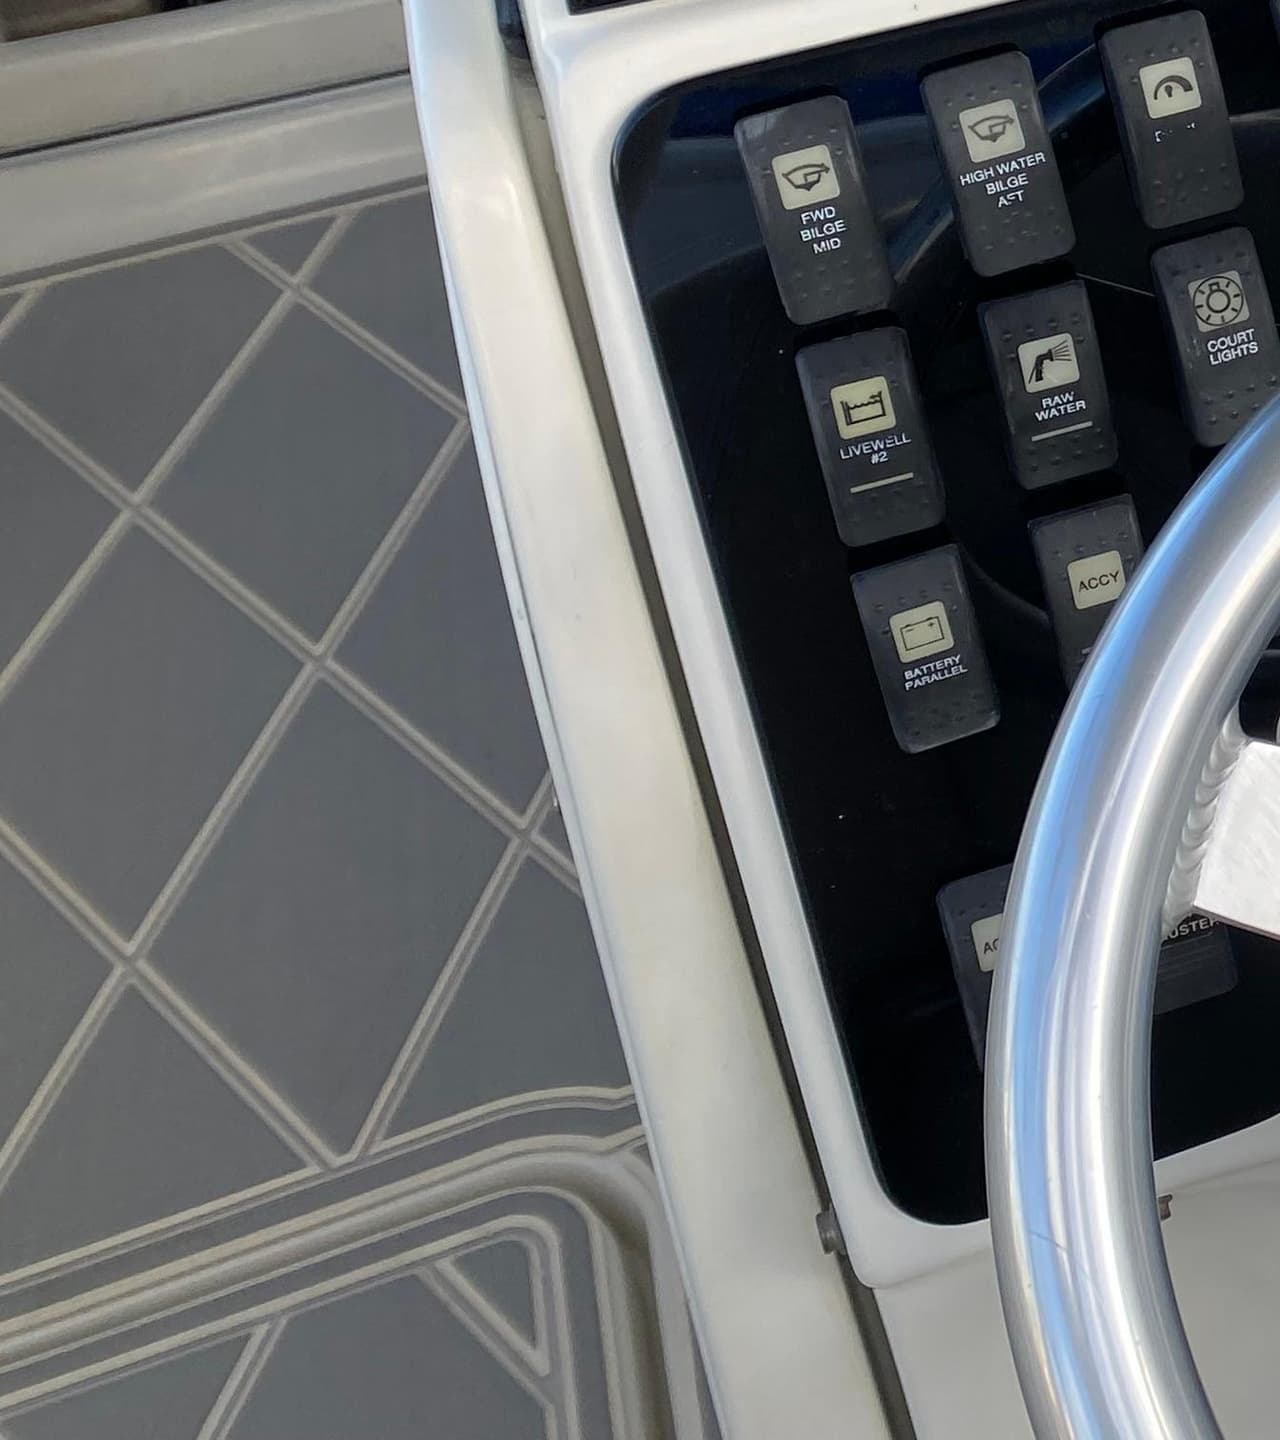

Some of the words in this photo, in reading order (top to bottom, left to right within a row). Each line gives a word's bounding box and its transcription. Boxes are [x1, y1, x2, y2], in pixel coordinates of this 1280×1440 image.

[959, 165, 994, 187] HIGH
[995, 151, 1046, 177] WATER
[985, 172, 1029, 196] BILGE
[801, 205, 836, 225] FWD
[799, 219, 848, 242] BILGE
[812, 236, 842, 255] MID
[1206, 328, 1255, 353] COURT
[1210, 340, 1259, 365] LIGHTS
[1034, 399, 1087, 422] WATER
[1041, 391, 1076, 409] RAW
[839, 432, 912, 460] LIVEWELL
[870, 451, 889, 465] #2
[1078, 570, 1120, 593] ACCY
[904, 654, 962, 681] BATTERY
[904, 663, 968, 692] PARALLEL
